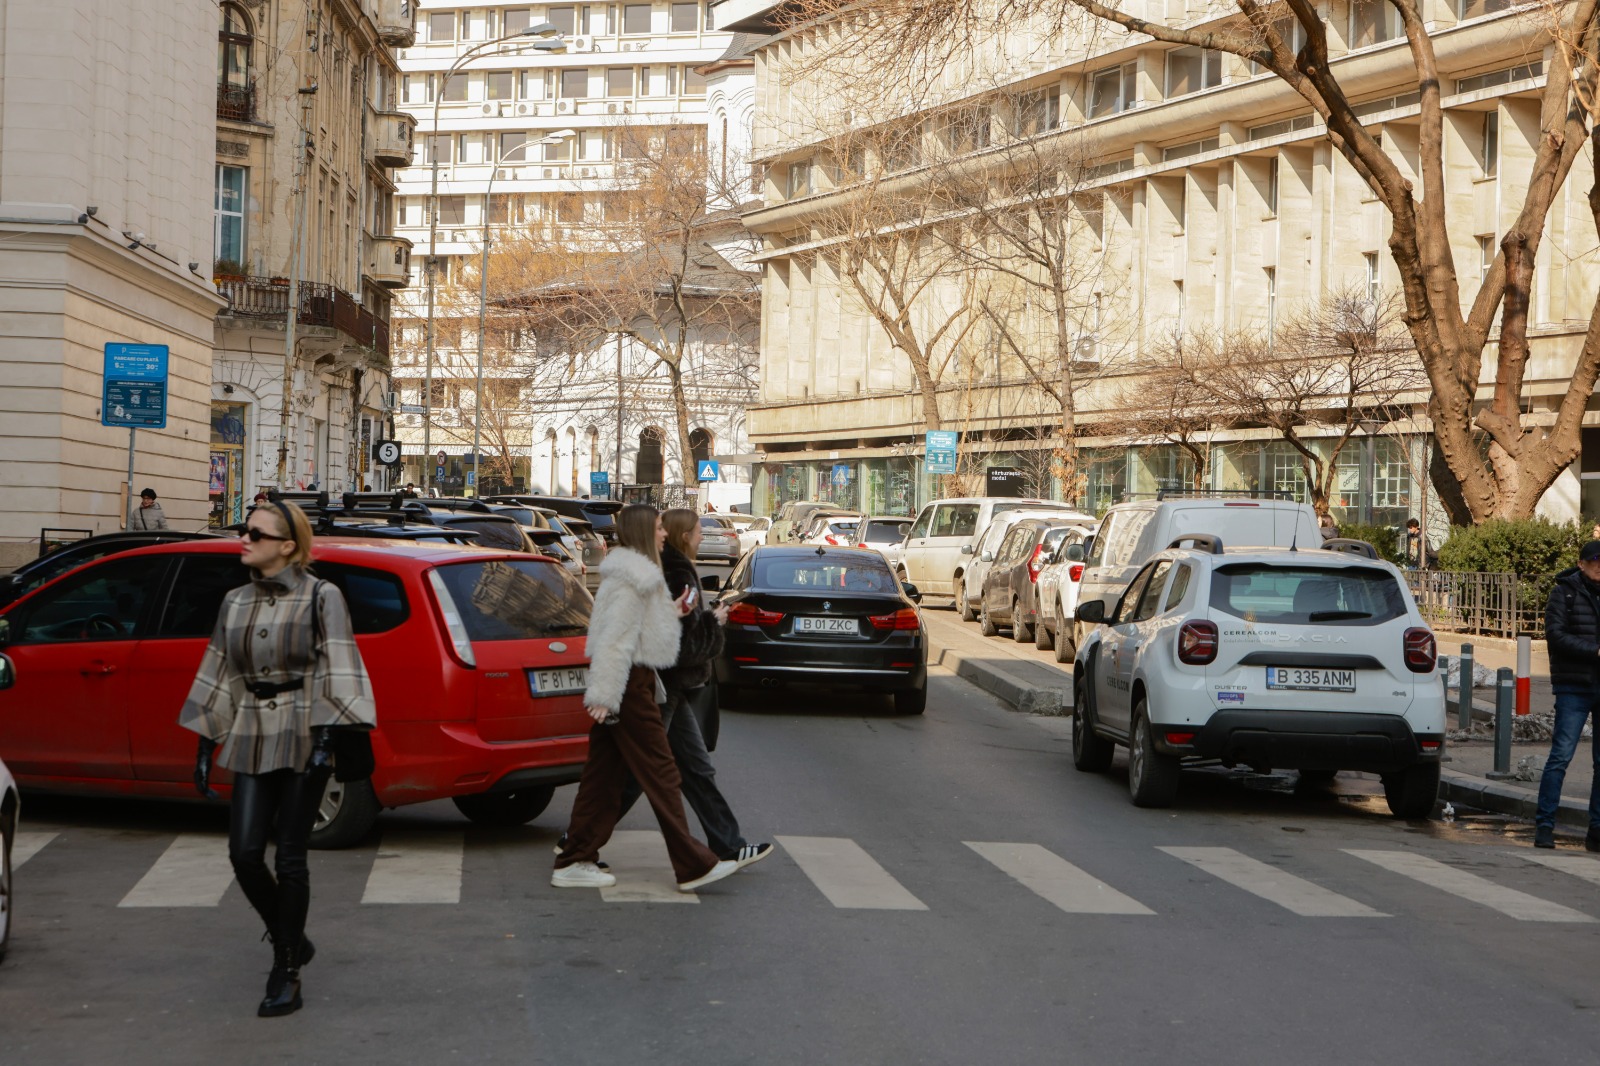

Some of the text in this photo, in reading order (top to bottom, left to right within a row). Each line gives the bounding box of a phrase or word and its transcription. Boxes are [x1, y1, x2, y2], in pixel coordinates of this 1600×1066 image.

[385, 445, 393, 457] 5
[803, 619, 852, 630] B 01 ZKC
[1278, 634, 1348, 643] DACIA
[538, 672, 549, 690] IF
[551, 671, 564, 689] 81
[1277, 669, 1352, 686] B 335 ANM
